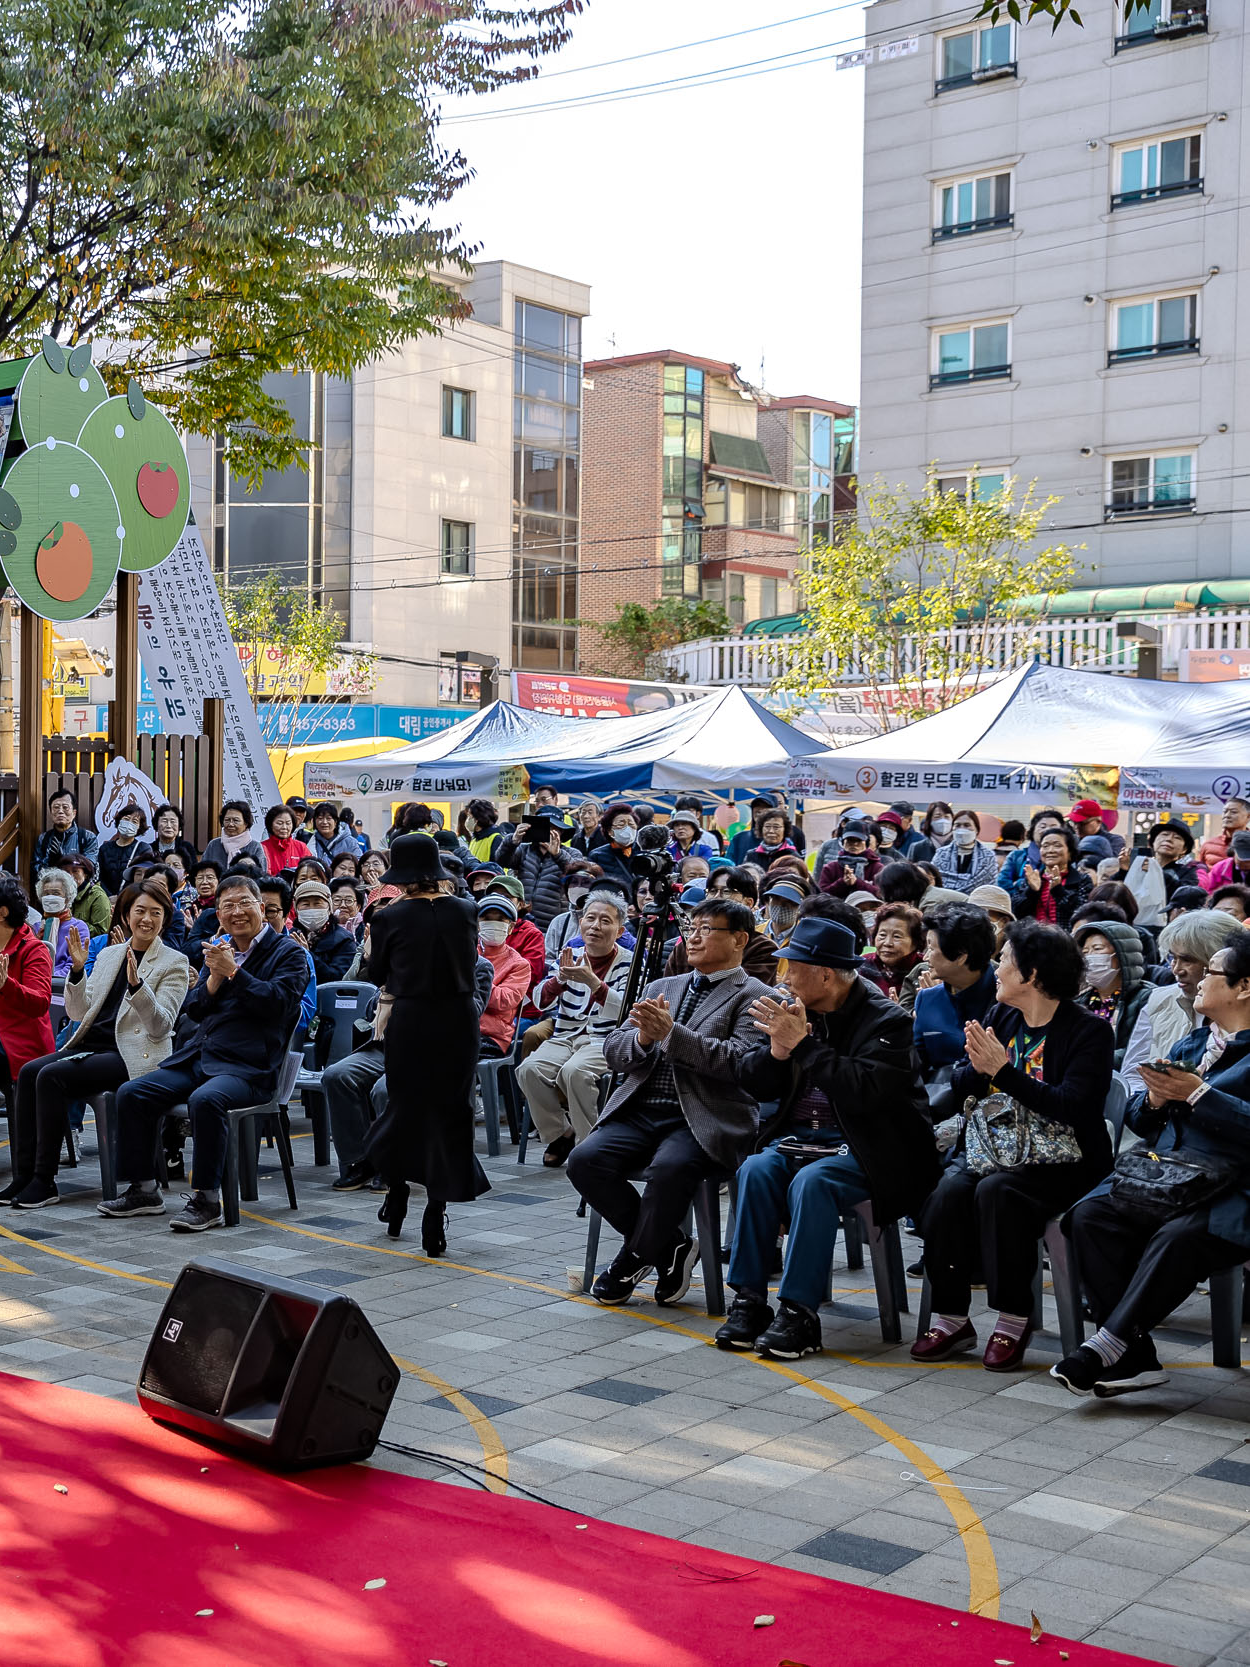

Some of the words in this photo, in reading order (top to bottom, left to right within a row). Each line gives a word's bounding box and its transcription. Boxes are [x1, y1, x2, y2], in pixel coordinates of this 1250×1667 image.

[399, 715, 421, 736] 대림
[361, 776, 367, 788] 4
[435, 777, 472, 793] 나눠요!
[862, 771, 871, 784] 3
[880, 771, 919, 789] 할로윈
[1014, 773, 1056, 791] 꾸미기
[1220, 780, 1232, 796] 2
